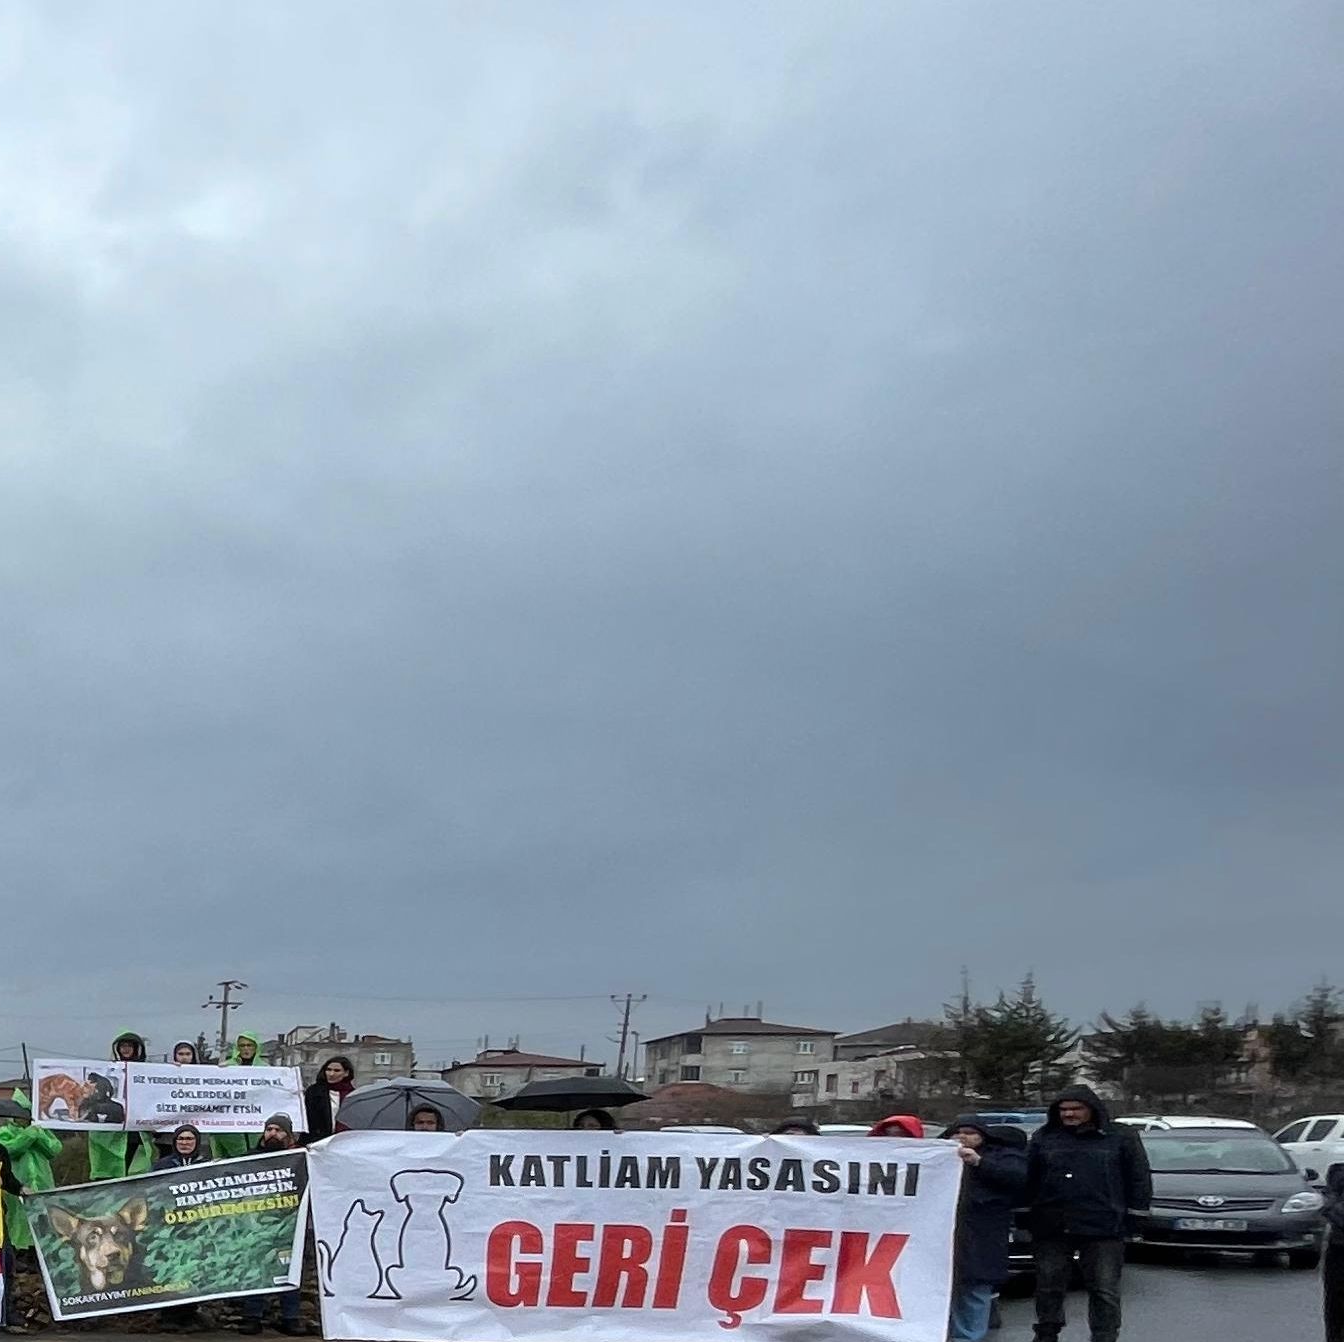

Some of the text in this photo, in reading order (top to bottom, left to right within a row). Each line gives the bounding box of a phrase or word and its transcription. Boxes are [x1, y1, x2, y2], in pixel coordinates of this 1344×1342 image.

[180, 1104, 231, 1114] MERHAMET
[233, 1104, 262, 1114] ETSİN
[234, 1091, 246, 1100] DE
[489, 1149, 920, 1197] KATLİAM YASASINI
[486, 1209, 911, 1329] GERİ ÇEK
